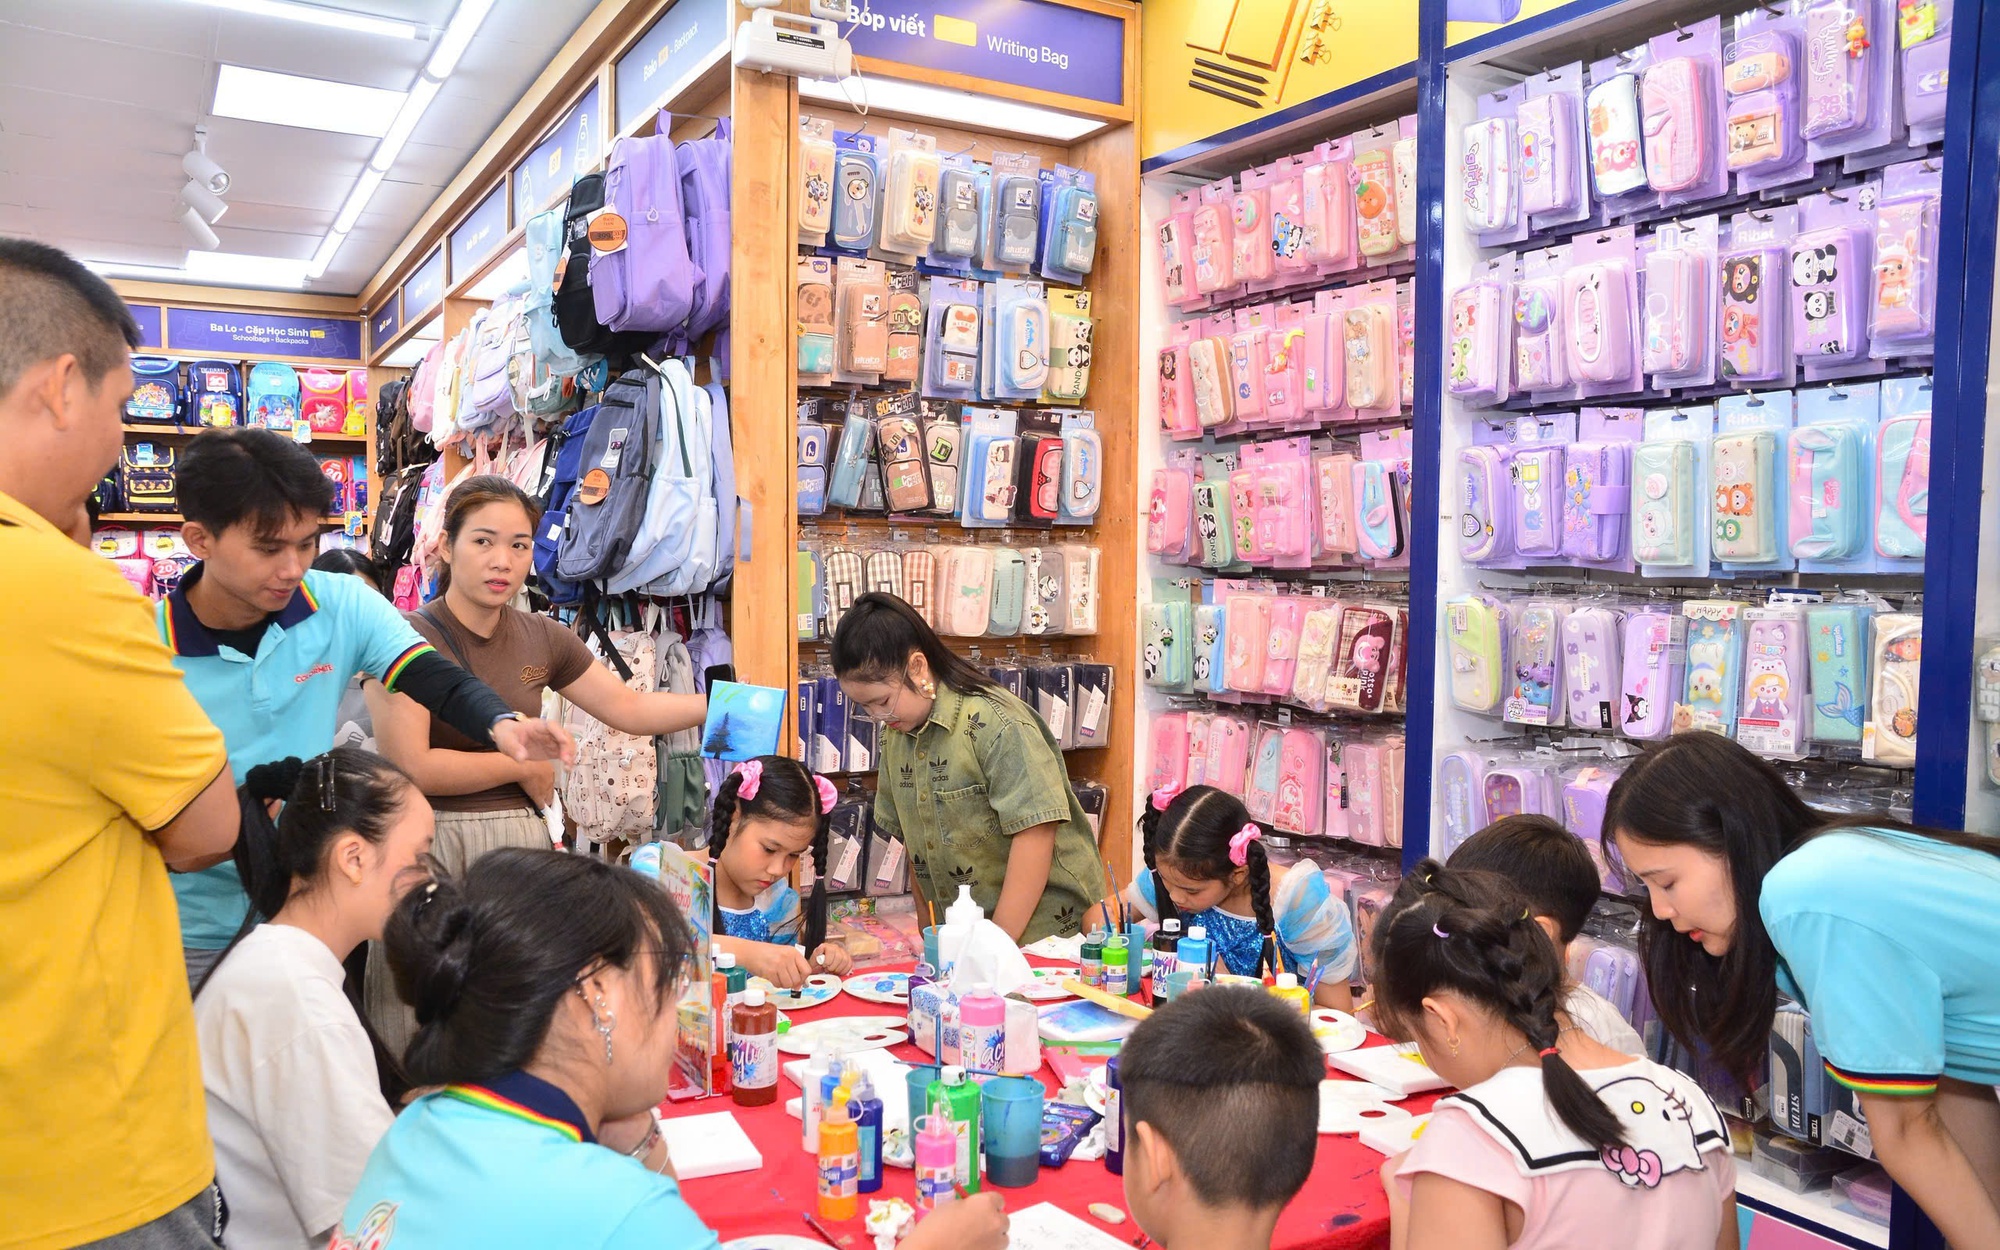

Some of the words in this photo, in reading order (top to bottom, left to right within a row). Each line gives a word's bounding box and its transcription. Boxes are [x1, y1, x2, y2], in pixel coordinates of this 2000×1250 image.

[847, 5, 885, 31] Bóp
[889, 12, 926, 38] viết
[643, 59, 658, 82] Balo
[674, 21, 699, 53] Backpack
[987, 34, 1038, 64] Writing
[1041, 46, 1069, 70] Bag
[1465, 153, 1479, 199] girly
[210, 323, 223, 332] Ba
[225, 324, 237, 333] Lo
[245, 325, 265, 338] Cặp
[268, 327, 286, 338] Học
[287, 328, 309, 337] Sinh
[232, 334, 270, 344] Schoolbags
[275, 337, 309, 345] Backpacks
[1072, 368, 1083, 396] PAND
[1209, 539, 1219, 564] PAND
[158, 565, 174, 574] 20
[1696, 606, 1722, 616] HAPPY
[1754, 642, 1786, 656] Happy
[520, 662, 548, 684] Bad
[1059, 920, 1079, 934] adidas
[824, 1171, 840, 1182] PAINT
